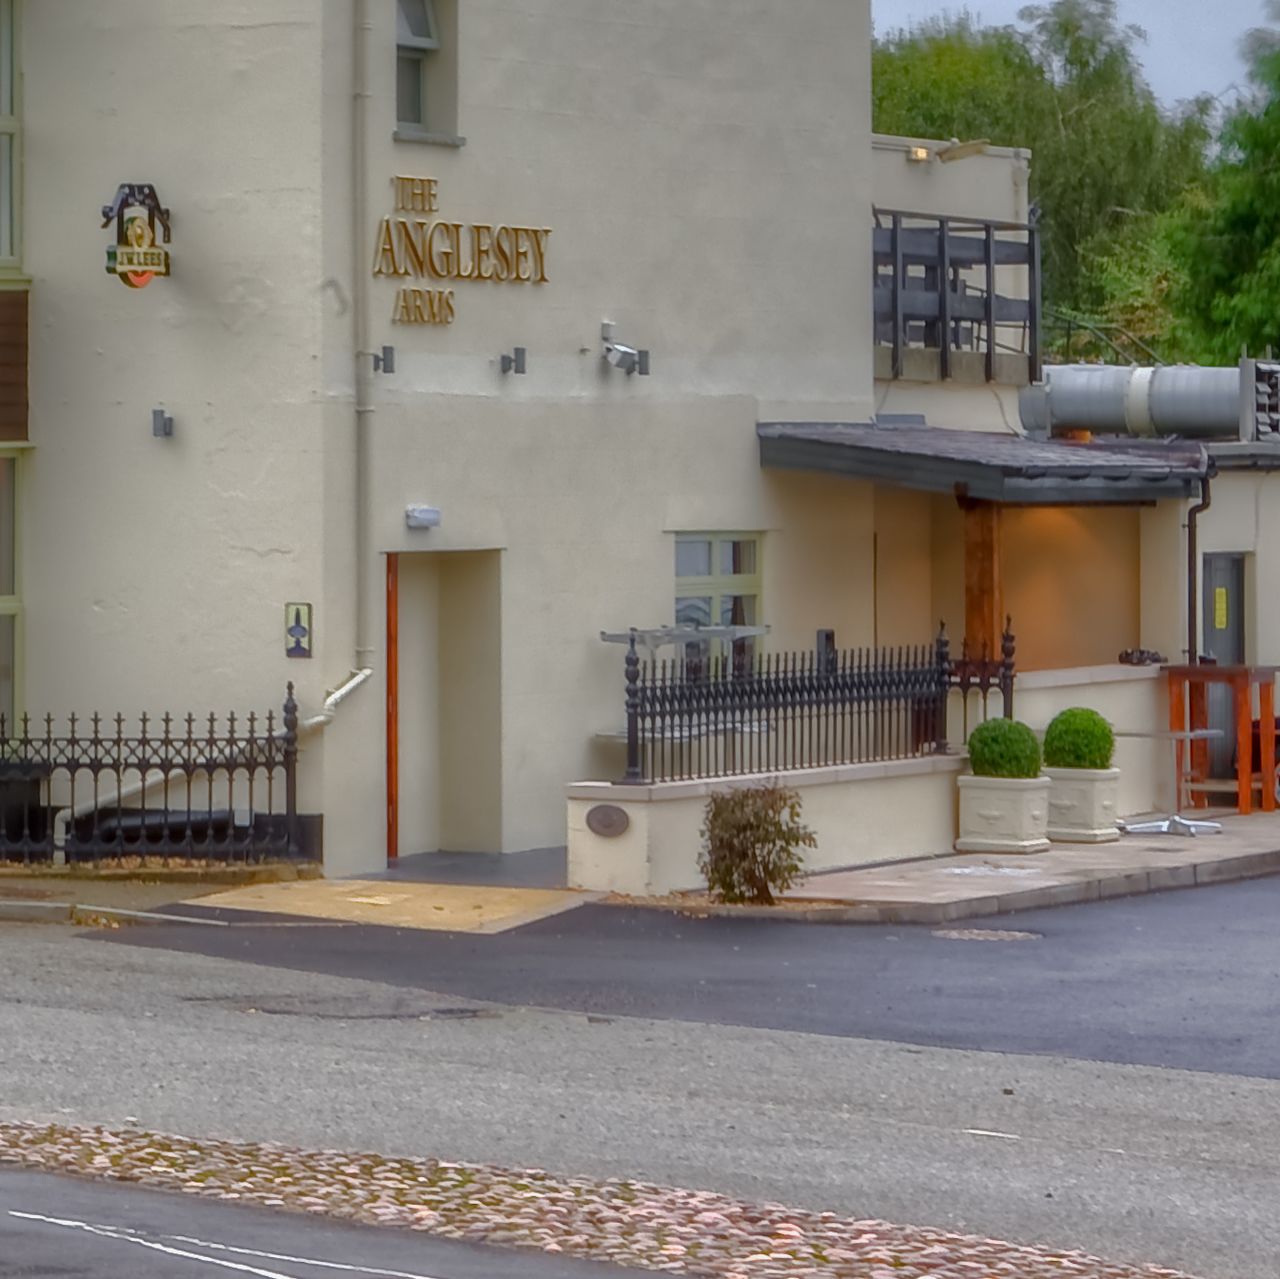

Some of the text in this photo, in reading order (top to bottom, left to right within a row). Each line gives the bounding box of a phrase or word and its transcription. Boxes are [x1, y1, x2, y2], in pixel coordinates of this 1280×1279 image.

[393, 175, 440, 213] THE
[373, 215, 553, 284] ANGLESEY
[392, 287, 456, 325] ARMS
